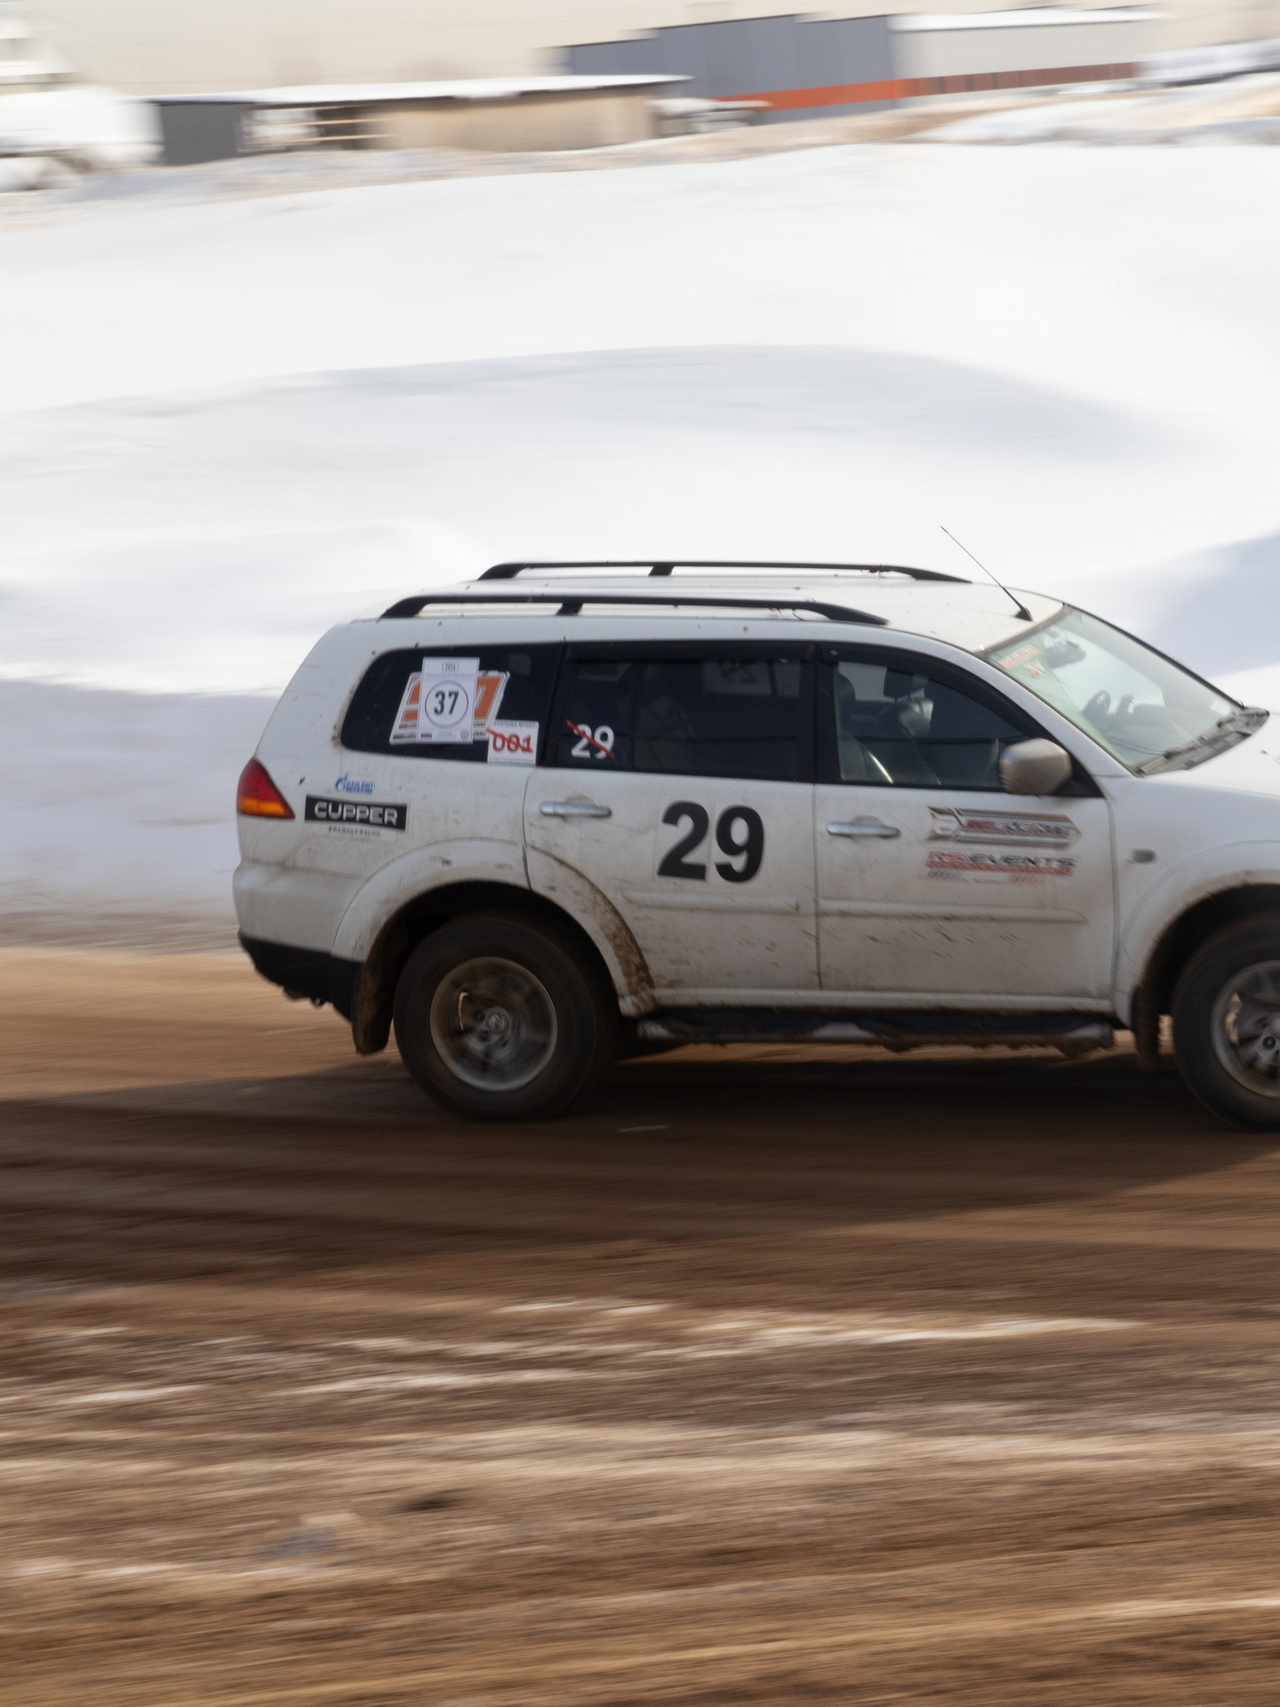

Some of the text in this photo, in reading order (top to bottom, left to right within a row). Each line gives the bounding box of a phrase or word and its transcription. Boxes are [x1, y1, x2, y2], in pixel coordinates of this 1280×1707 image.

[434, 690, 459, 715] 37
[493, 733, 533, 754] 001
[571, 724, 615, 759] 29
[314, 801, 398, 826] CUPPER
[657, 801, 764, 882] 29
